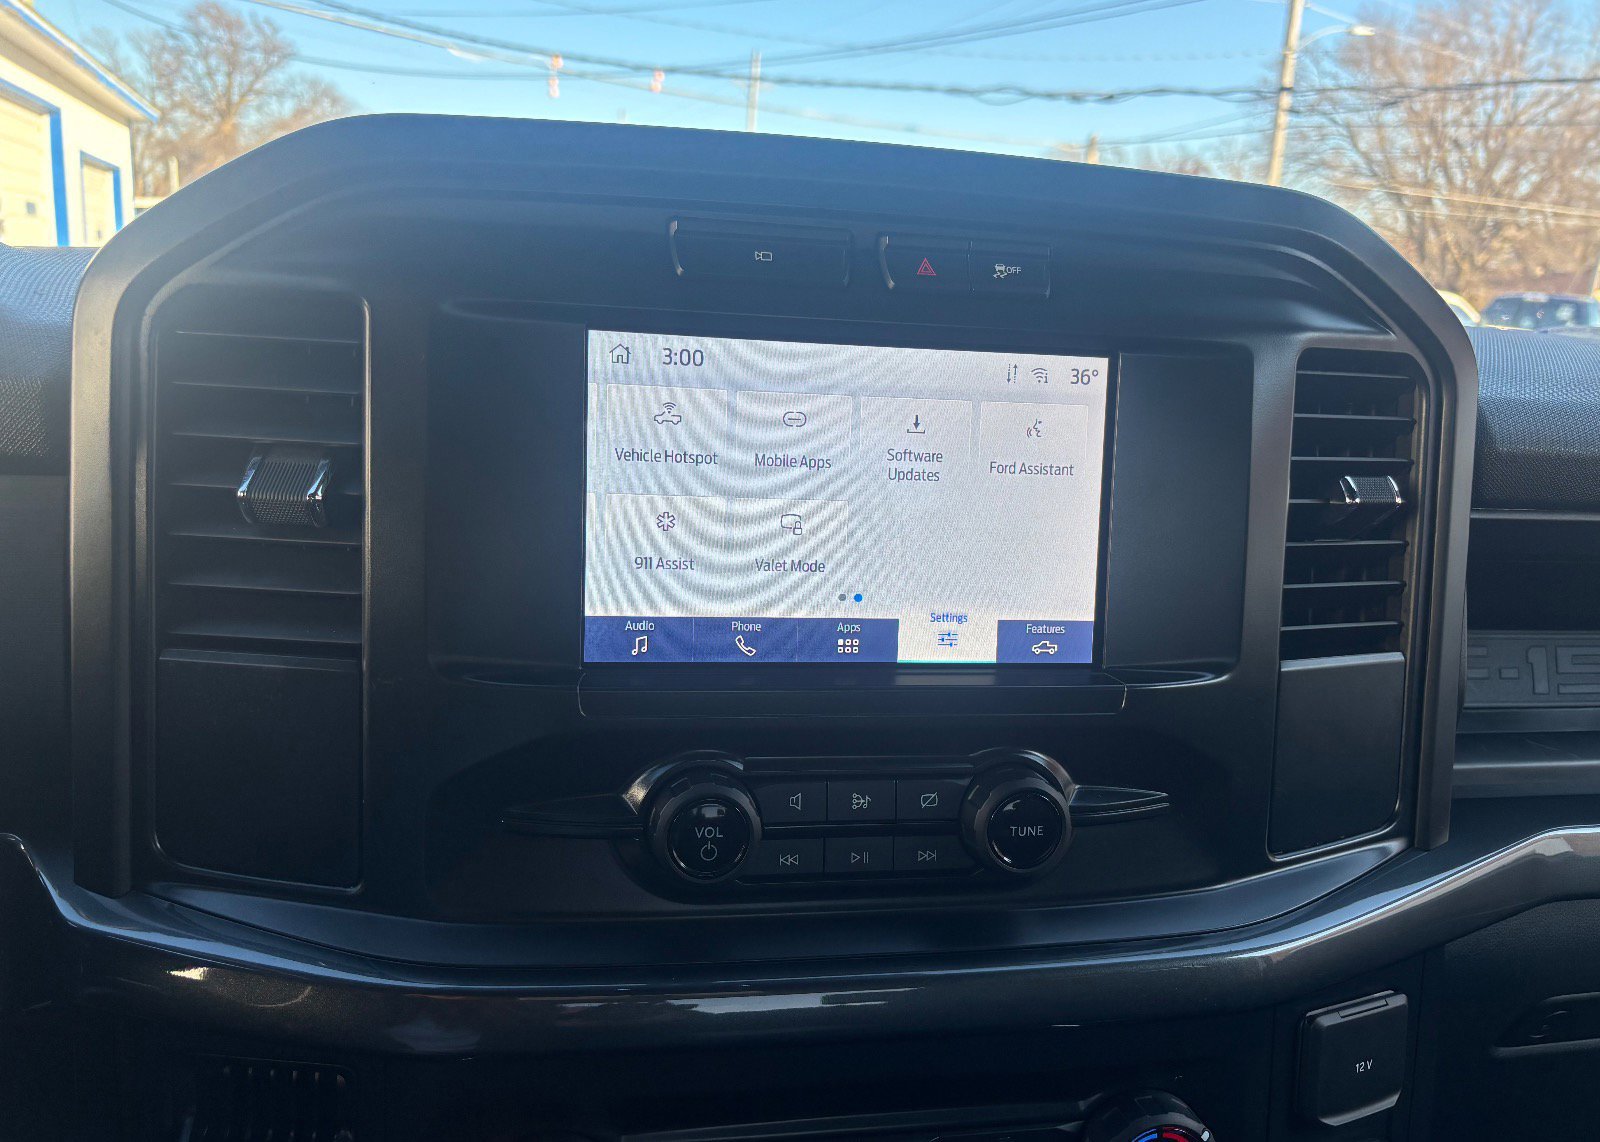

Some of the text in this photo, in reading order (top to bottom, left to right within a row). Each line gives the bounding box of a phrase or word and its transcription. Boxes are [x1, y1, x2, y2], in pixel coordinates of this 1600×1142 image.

[1006, 266, 1022, 275] OFF
[662, 347, 704, 367] 3:00
[1070, 368, 1099, 386] 36°
[614, 447, 719, 467] Vehicle Hotspot
[754, 453, 832, 471] Mobile Apps
[886, 448, 943, 464] Software
[887, 467, 940, 483] Updates
[989, 461, 1075, 477] Ford Assistant
[634, 556, 695, 571] 911 Assist
[755, 558, 826, 573] Valet Mode
[625, 620, 655, 632] Audio
[930, 612, 968, 625] Settings
[731, 621, 762, 632] Phone
[837, 622, 861, 634] Apps
[1026, 623, 1066, 635] Features
[694, 826, 724, 840] VOL
[1010, 825, 1044, 837] TUNE
